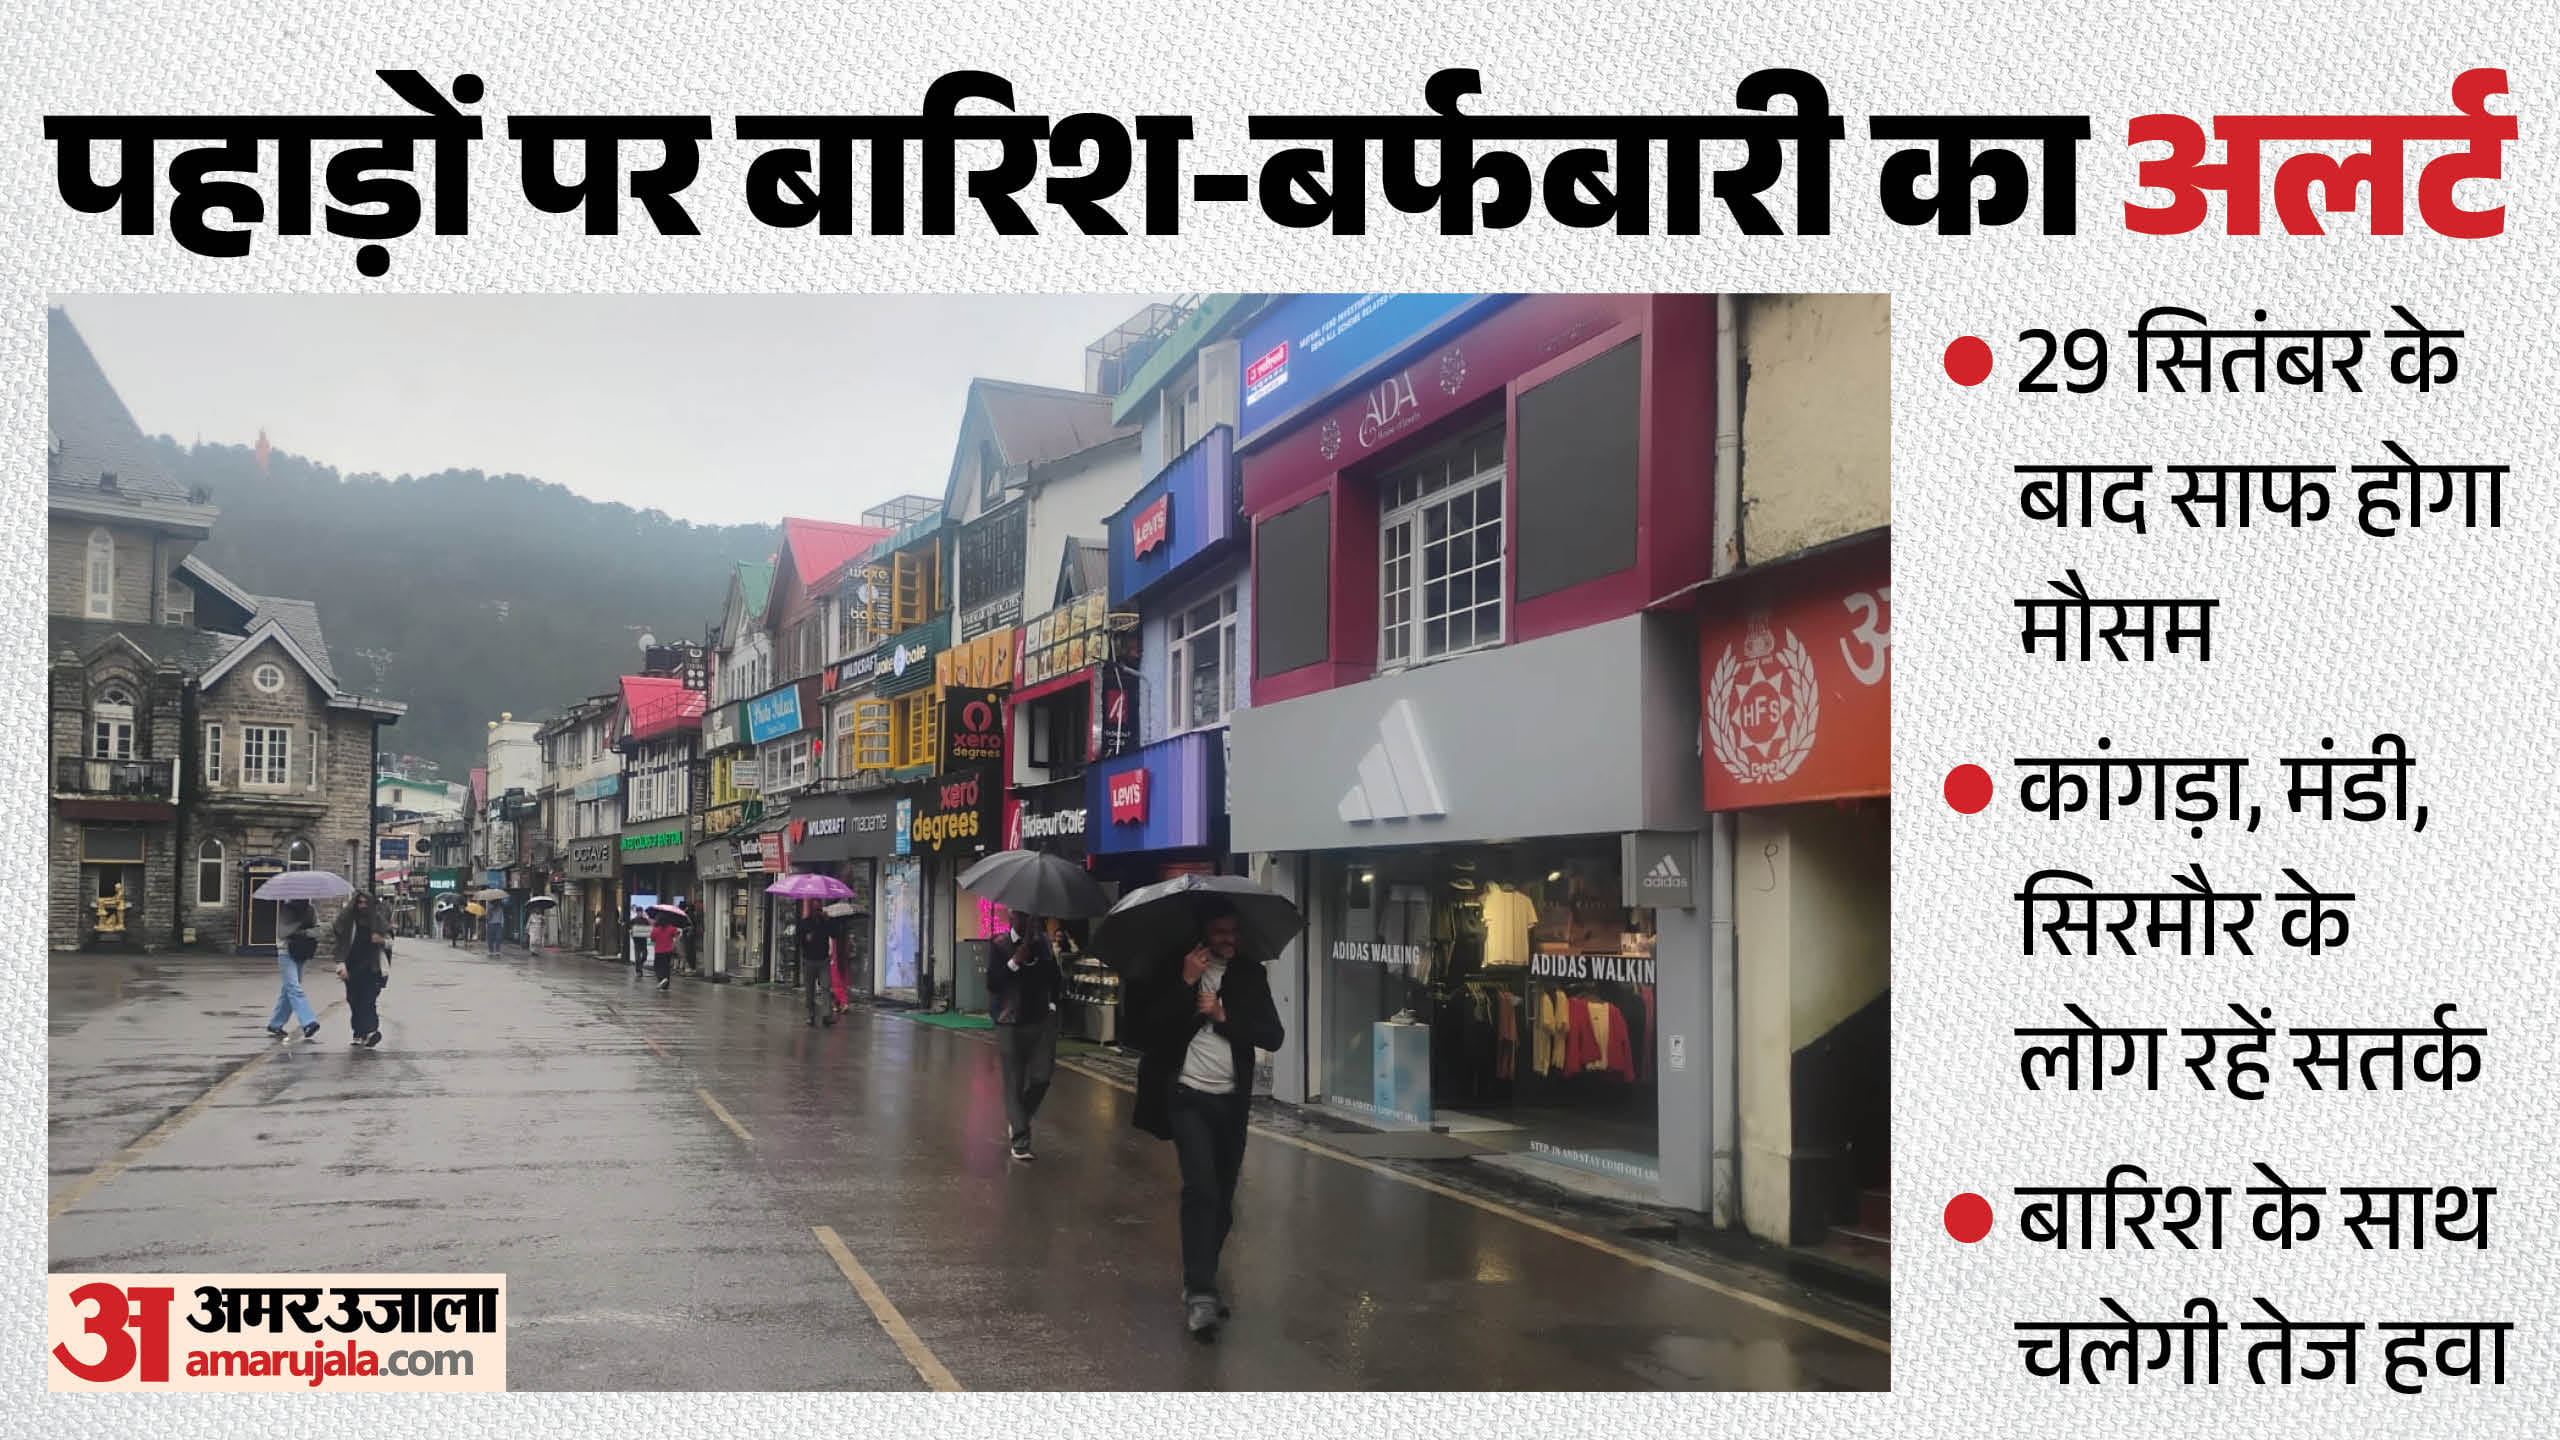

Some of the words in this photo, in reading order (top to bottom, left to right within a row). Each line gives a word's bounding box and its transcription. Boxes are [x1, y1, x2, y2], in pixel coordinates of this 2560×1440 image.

[1743, 695, 1780, 728] HFS
[954, 732, 1001, 748] xero
[953, 746, 1000, 760] degrees
[941, 779, 978, 809] xero
[808, 817, 846, 837] WILDCRAFT
[912, 809, 978, 851] degrees
[1643, 876, 1688, 888] adidas
[1332, 940, 1369, 961] ADIDAS
[1371, 943, 1420, 965] WALKING
[1531, 952, 1587, 978] ADIDAS
